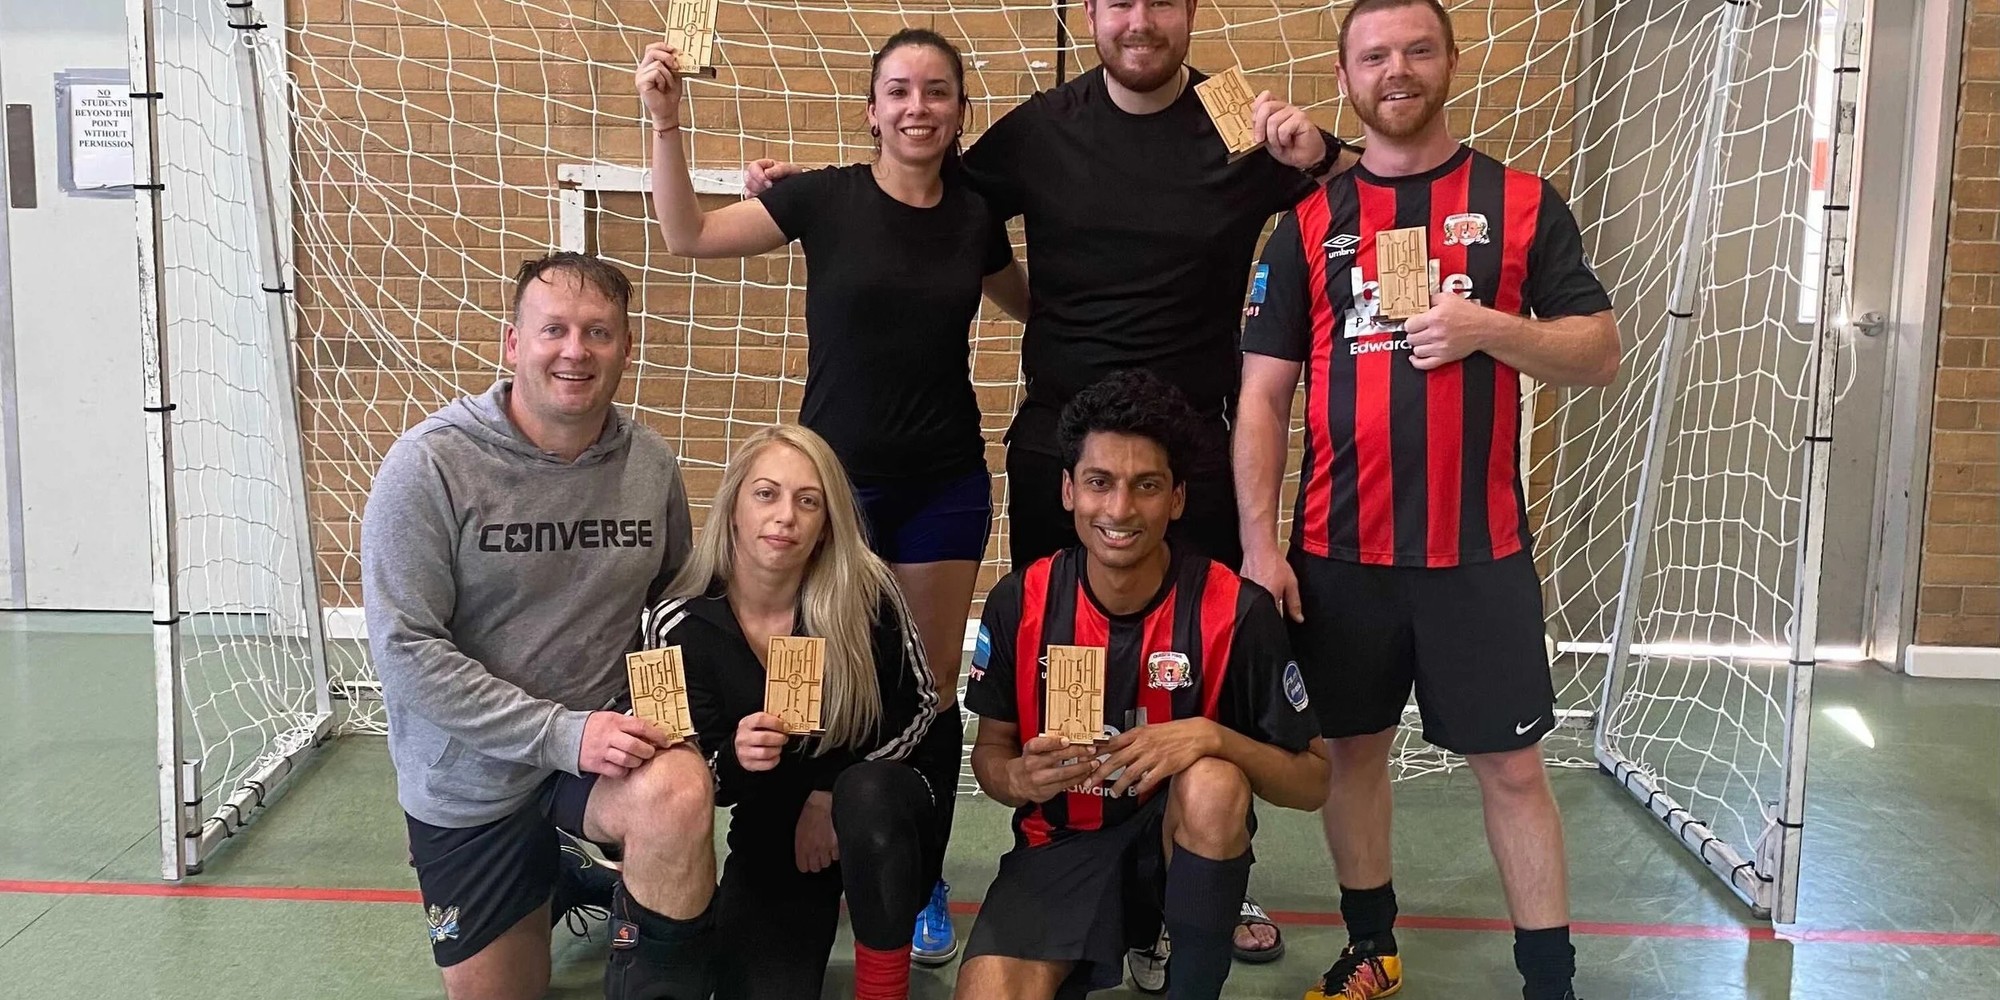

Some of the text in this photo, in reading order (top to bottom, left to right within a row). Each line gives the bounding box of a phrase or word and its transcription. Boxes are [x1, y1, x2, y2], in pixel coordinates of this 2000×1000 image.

[97, 89, 111, 98] NO
[81, 99, 128, 107] STUDENTS
[75, 109, 132, 117] BEYOND THI
[91, 120, 119, 128] POINT
[84, 130, 127, 138] WITHOUT
[79, 140, 134, 148] PERMISSION
[1328, 247, 1356, 259] umbro
[478, 519, 653, 553] CONVERSE
